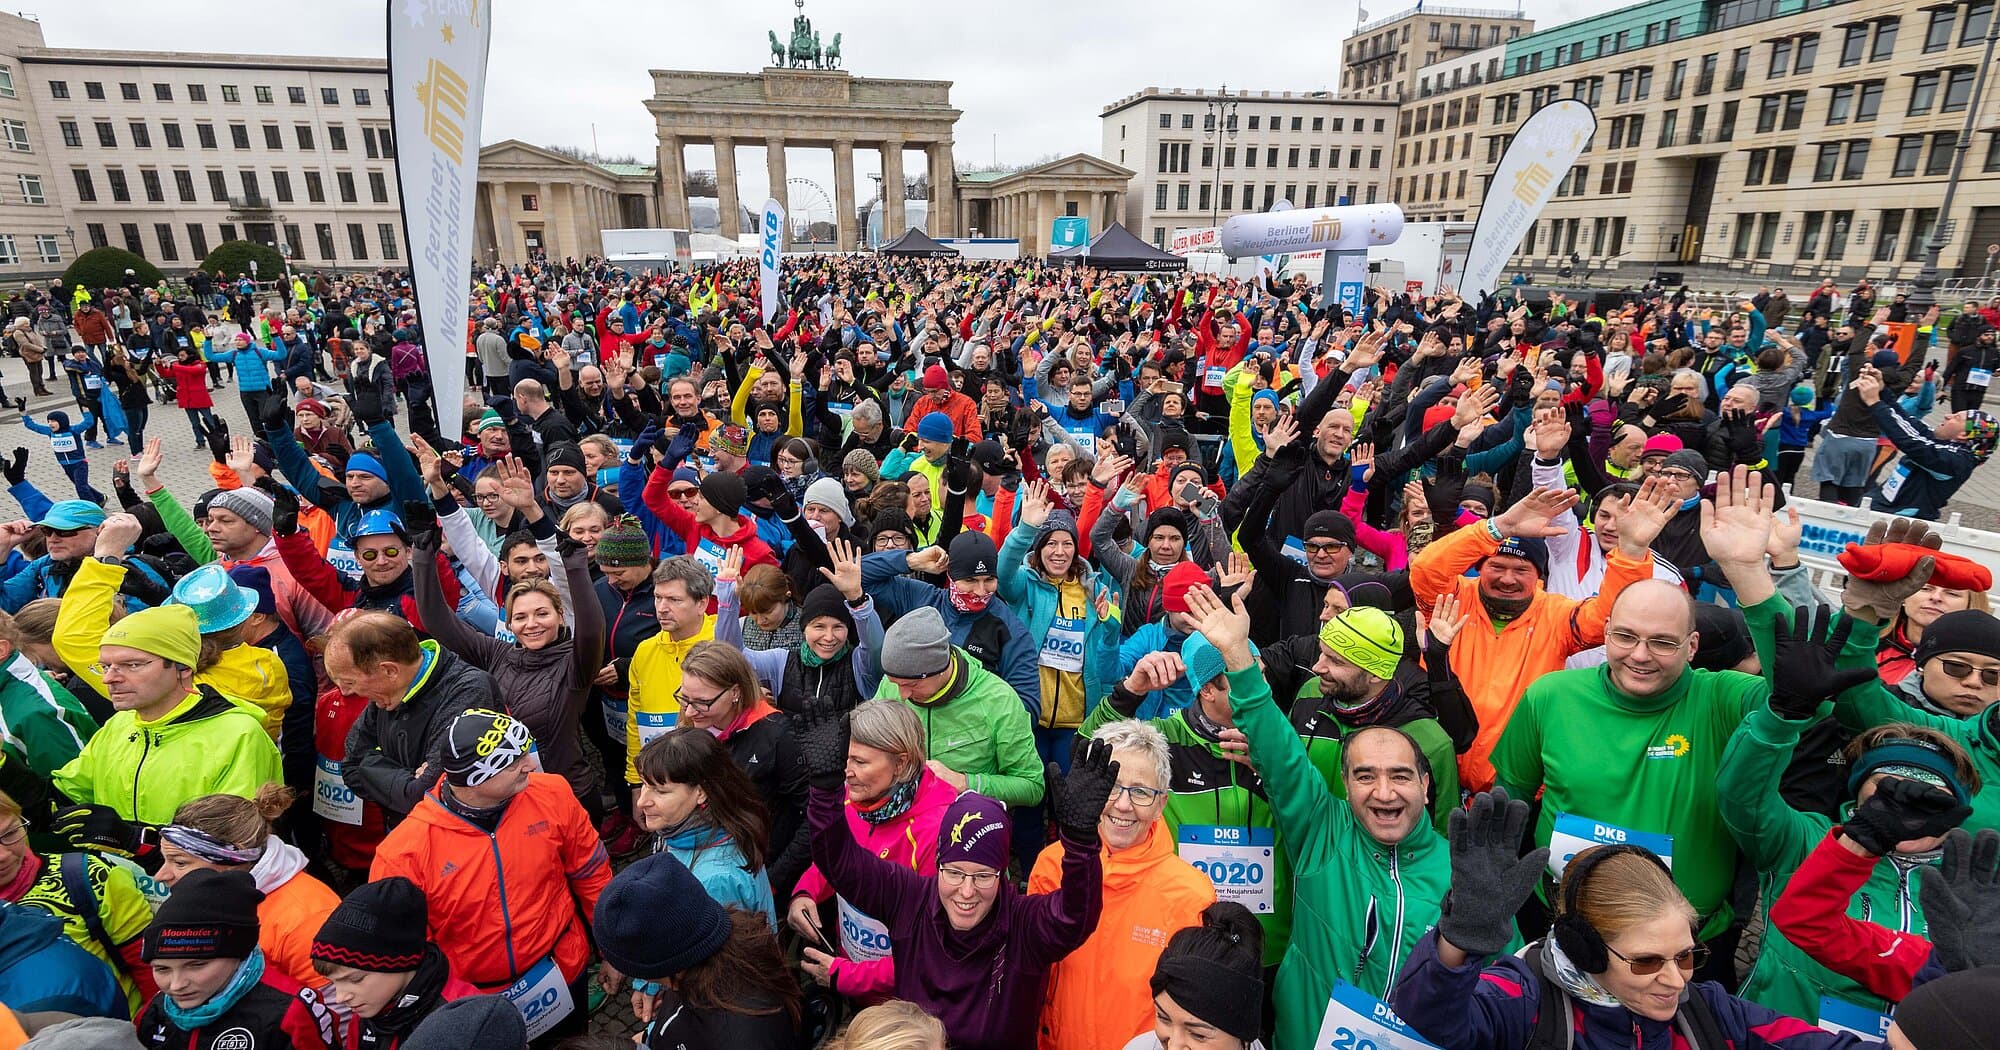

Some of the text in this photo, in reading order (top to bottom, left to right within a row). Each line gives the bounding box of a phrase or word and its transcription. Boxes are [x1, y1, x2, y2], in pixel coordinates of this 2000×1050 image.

[425, 153, 445, 272] Berliner
[1267, 225, 1311, 238] Berliner
[1484, 200, 1520, 249] Berliner
[763, 210, 778, 270] DKB
[1189, 234, 1201, 247] WAS
[1201, 230, 1215, 245] HIER
[1242, 234, 1312, 249] Neujahrslauf
[1477, 204, 1529, 282] Neujahrslauf
[440, 160, 463, 348] Neujahrslauf
[1496, 545, 1526, 557] VERIGE
[1055, 618, 1073, 627] DKB
[968, 644, 984, 653] GORE
[325, 760, 339, 770] DKB
[317, 780, 356, 804] 2020
[963, 822, 1004, 852] HAI HAMBURG
[1214, 828, 1240, 840] DKB
[1594, 824, 1627, 842] DKB
[138, 876, 170, 897] 20
[842, 911, 892, 951] 2020
[502, 980, 529, 1000] DKB
[523, 987, 558, 1021] 20
[1373, 1002, 1406, 1026] DKB
